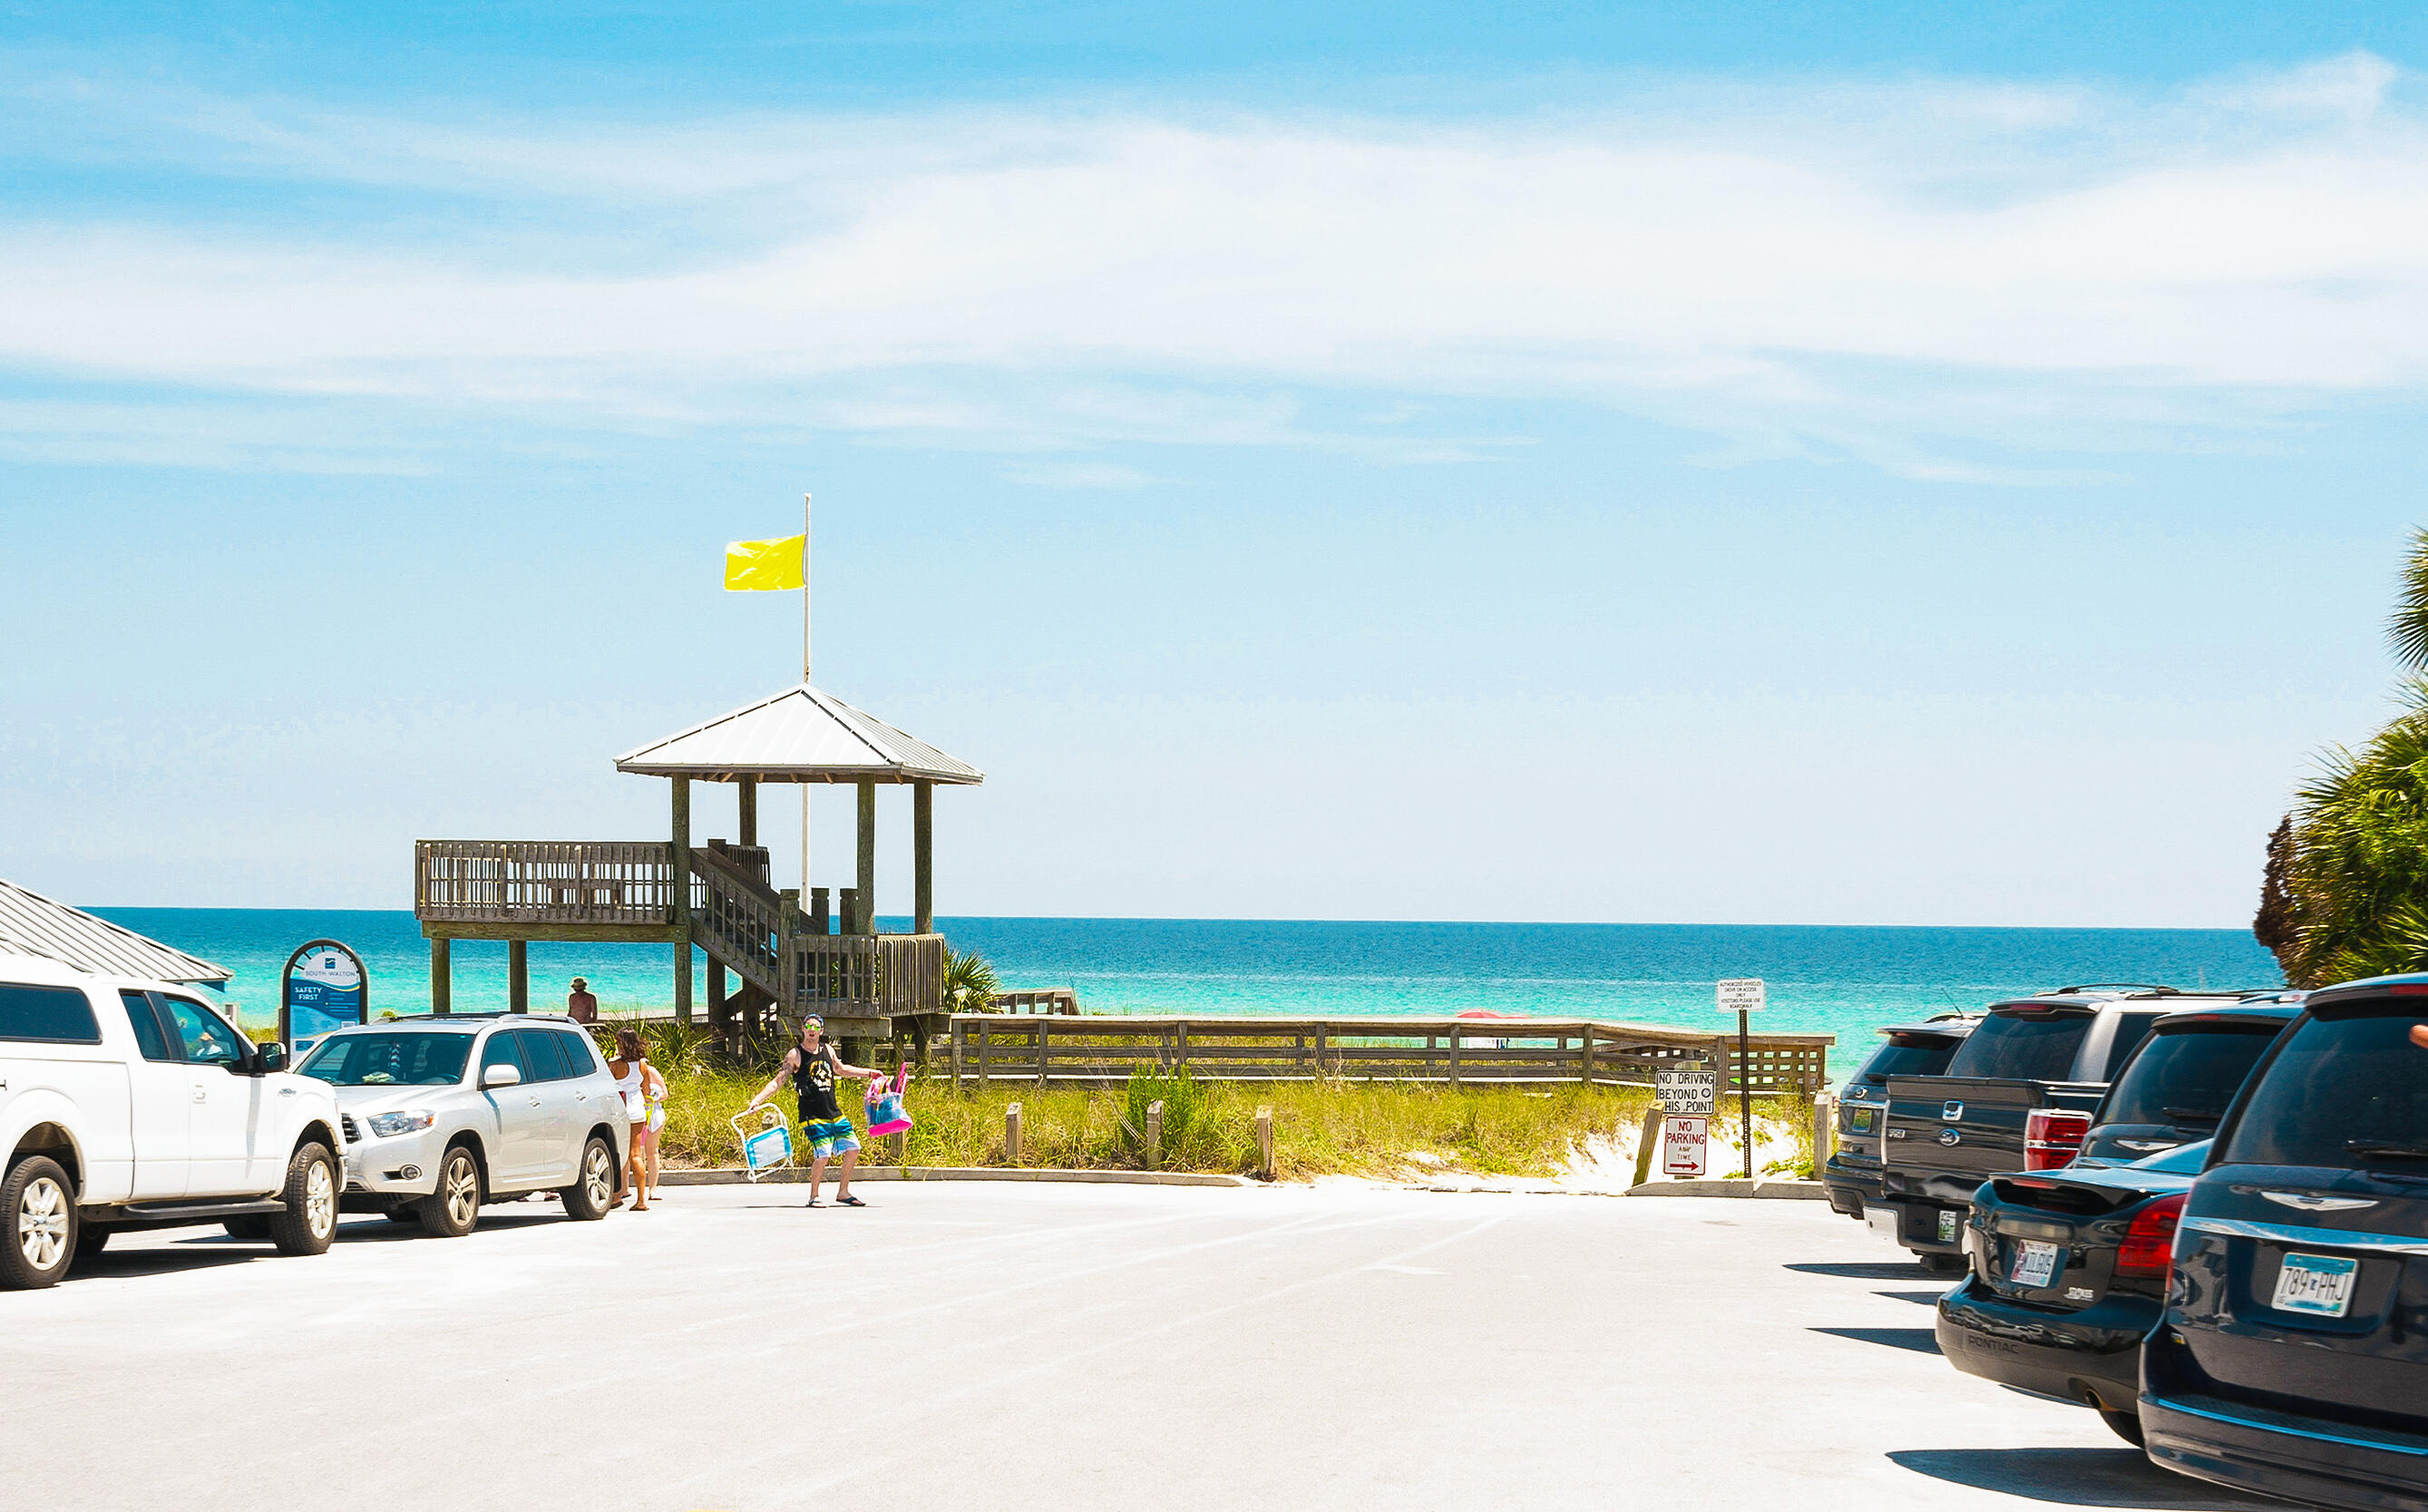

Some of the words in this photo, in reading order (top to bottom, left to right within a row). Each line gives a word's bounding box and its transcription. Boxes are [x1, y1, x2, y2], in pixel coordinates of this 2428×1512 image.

[1659, 1073, 1672, 1084] NO
[1678, 1073, 1713, 1085] DRIVING
[1659, 1088, 1698, 1099] BEYOND
[1664, 1101, 1681, 1112] HIS
[1686, 1101, 1713, 1112] POINT
[1678, 1120, 1692, 1132] NO
[1666, 1132, 1705, 1145] PARKING
[2280, 1267, 2310, 1296] 789
[2315, 1272, 2349, 1301] PHJ
[1968, 1334, 2019, 1354] PONTIAC
